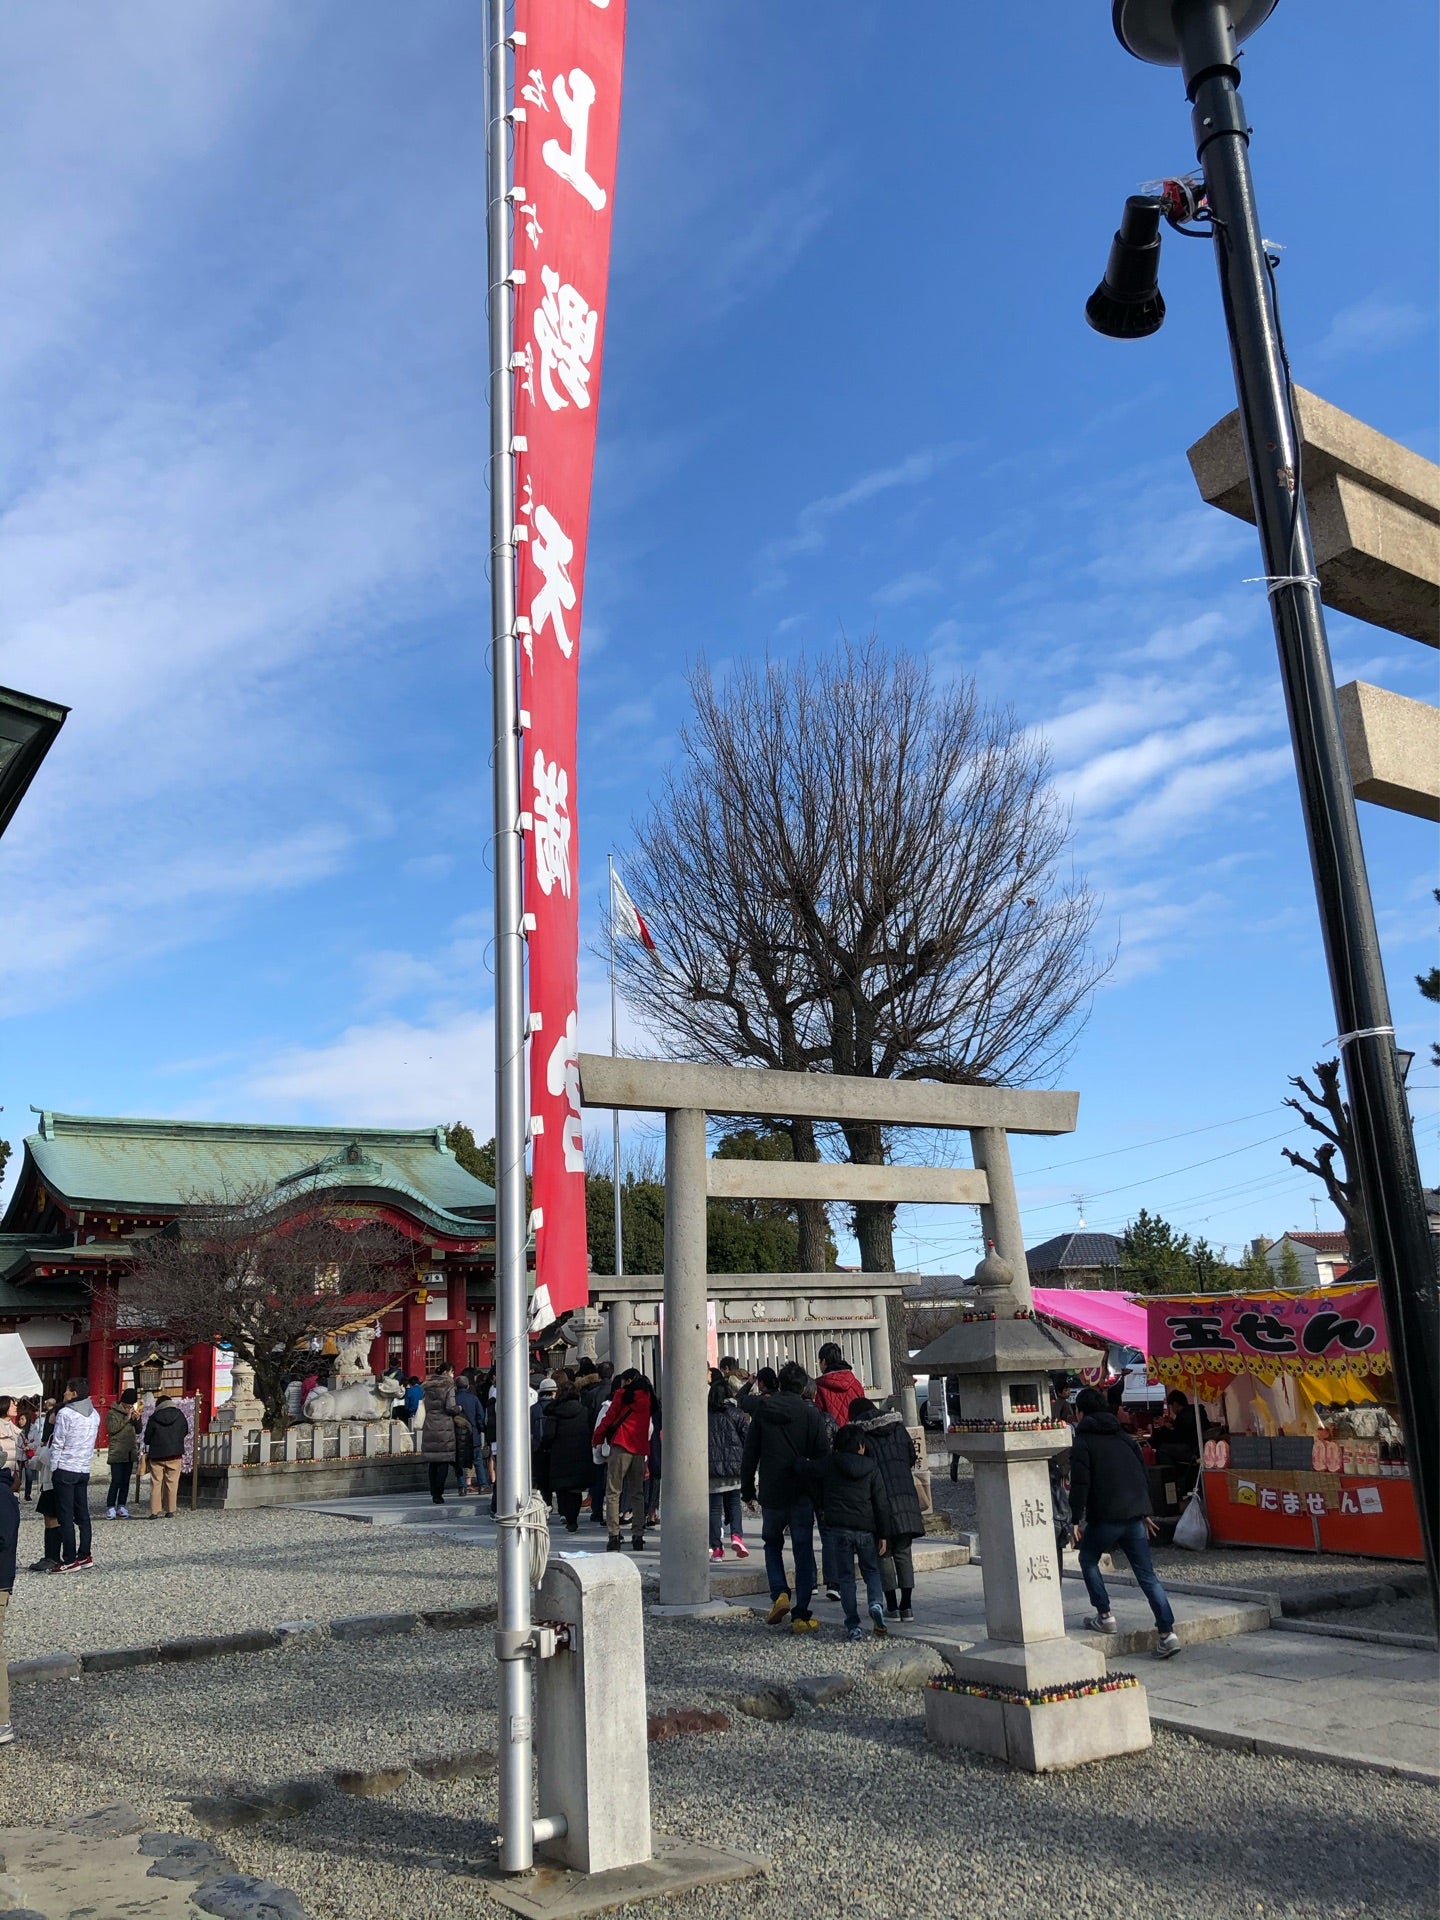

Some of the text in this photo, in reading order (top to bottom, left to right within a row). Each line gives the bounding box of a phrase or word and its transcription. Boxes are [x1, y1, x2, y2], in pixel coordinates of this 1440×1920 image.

[1166, 1311, 1376, 1354] 玉せん
[1260, 1488, 1359, 1515] たません
[1020, 1499, 1052, 1584] 献燈
